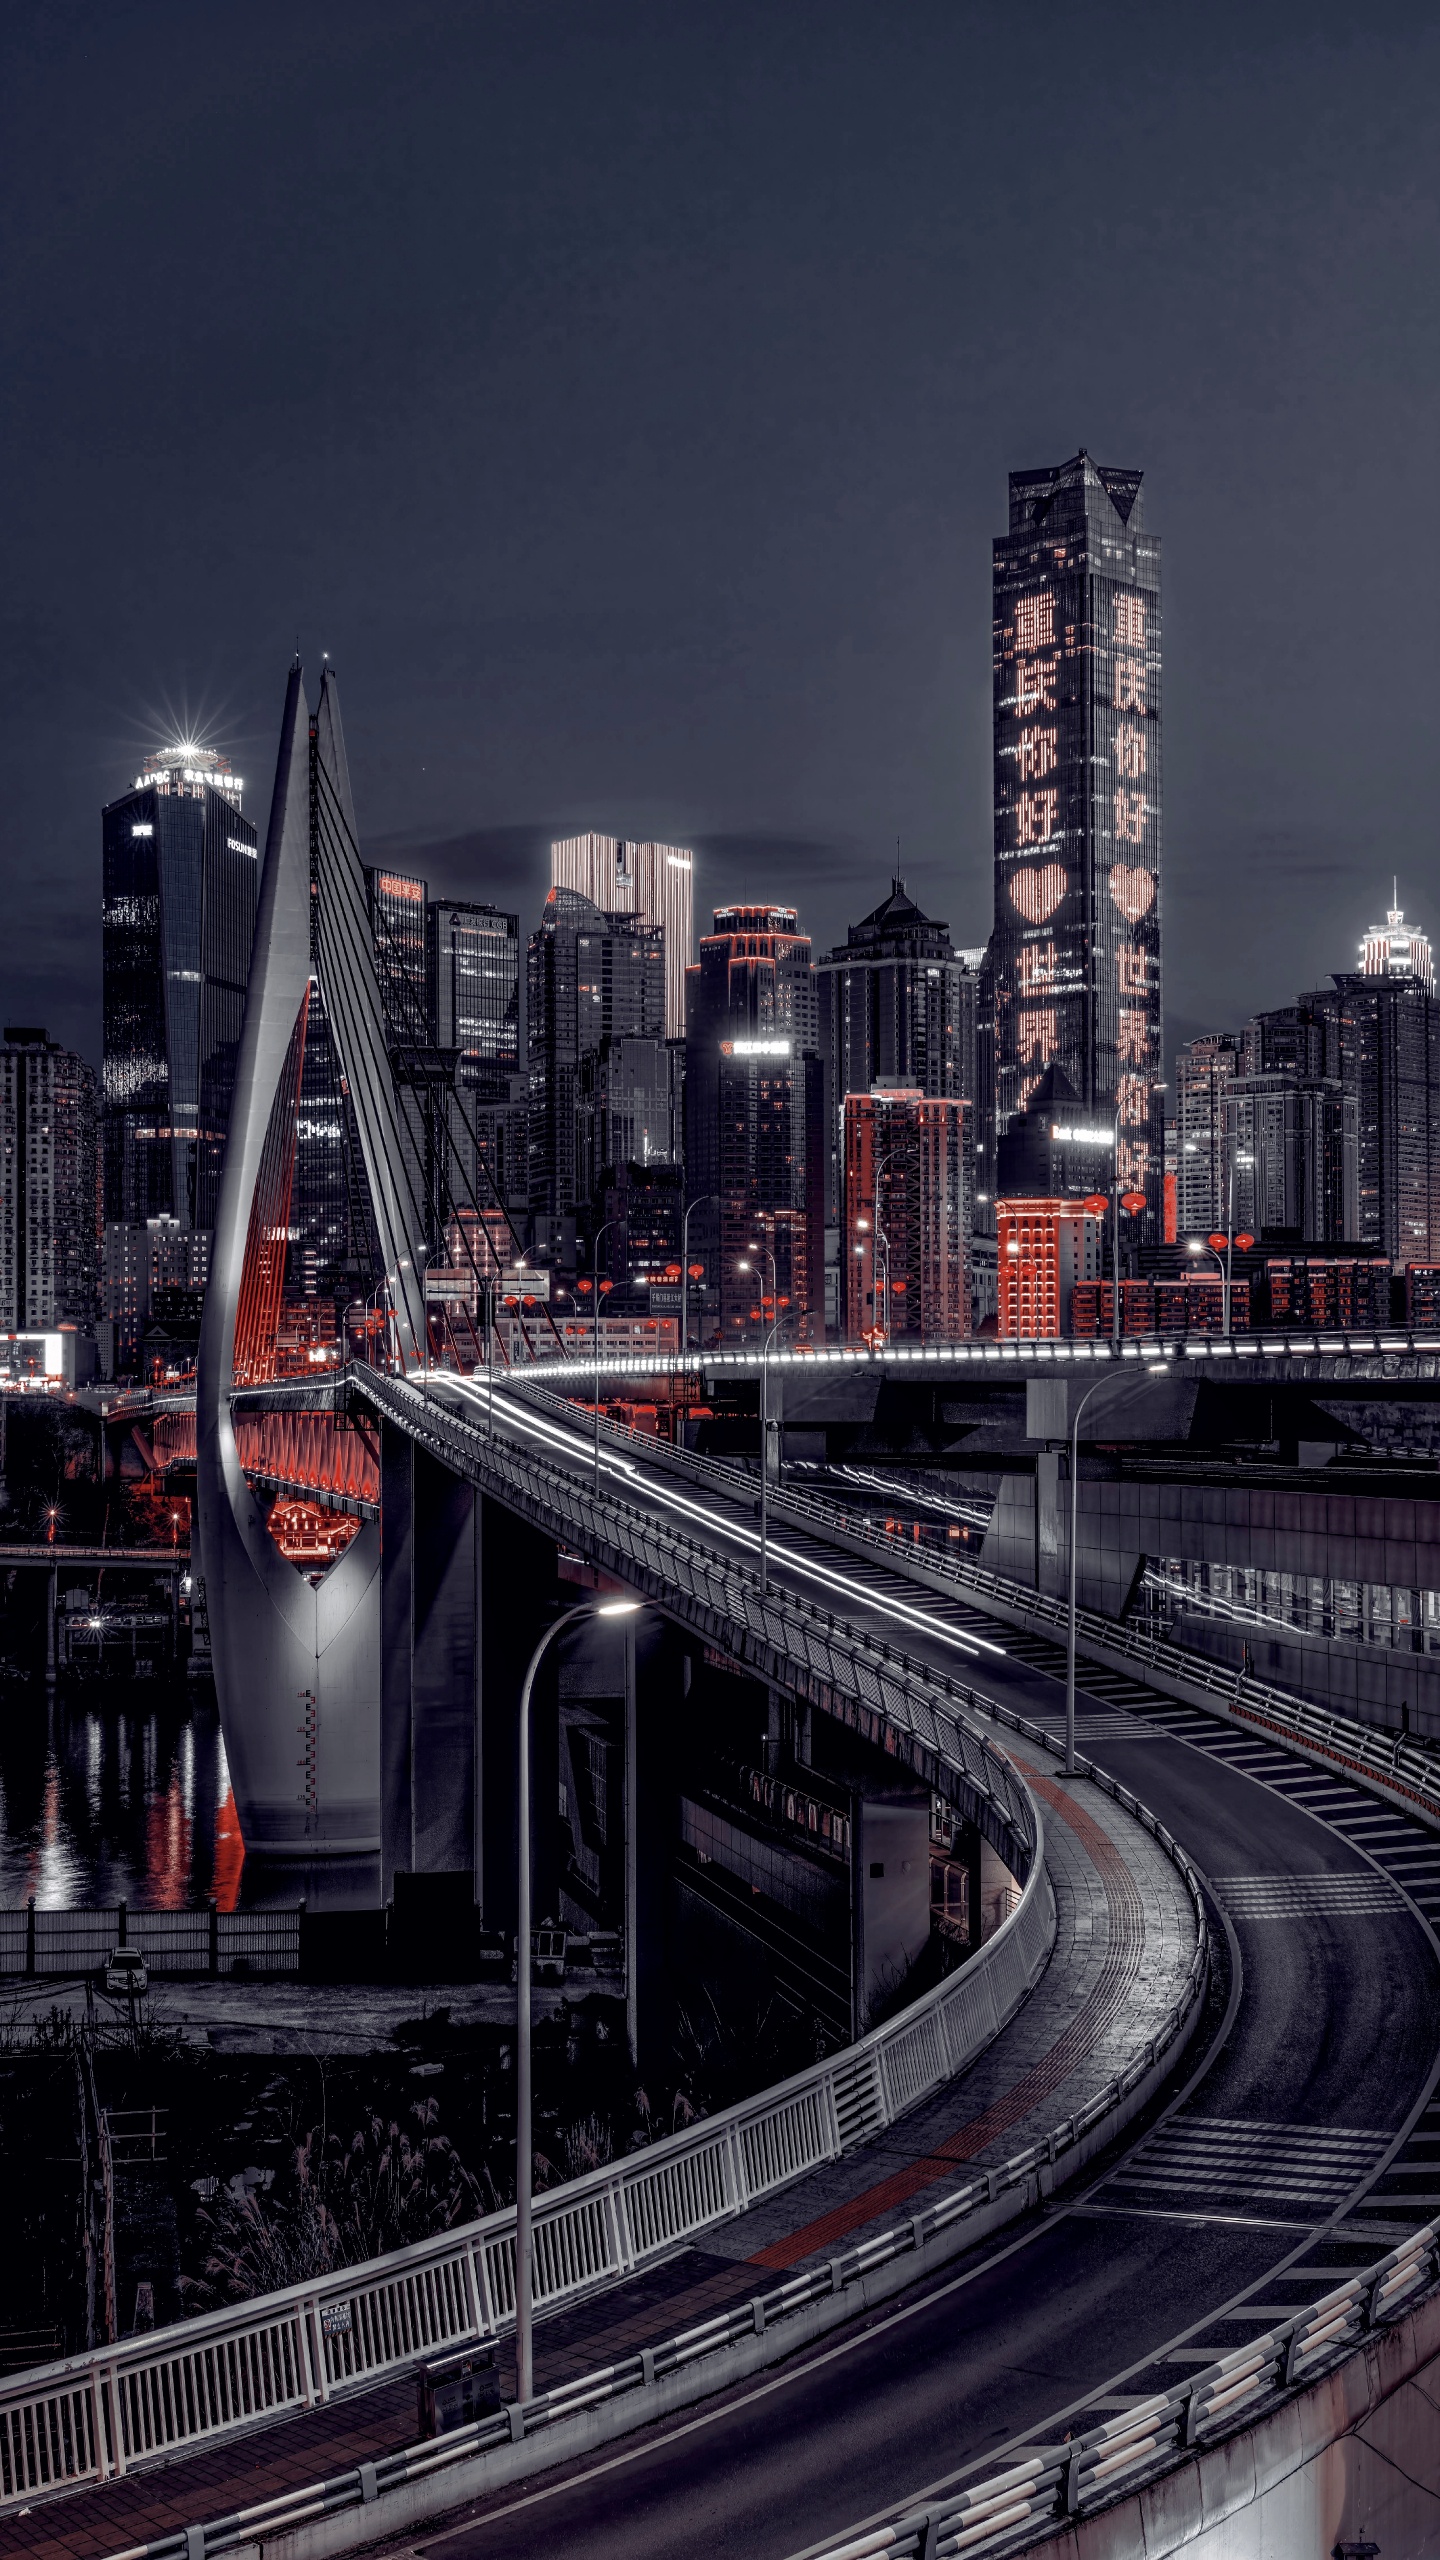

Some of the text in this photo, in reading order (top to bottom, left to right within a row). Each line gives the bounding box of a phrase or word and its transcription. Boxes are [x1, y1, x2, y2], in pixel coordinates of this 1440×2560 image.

[1015, 592, 1058, 845] 重庆你好
[381, 878, 421, 901] 中国平安
[1112, 591, 1149, 1191] 重庆你好 世界你好
